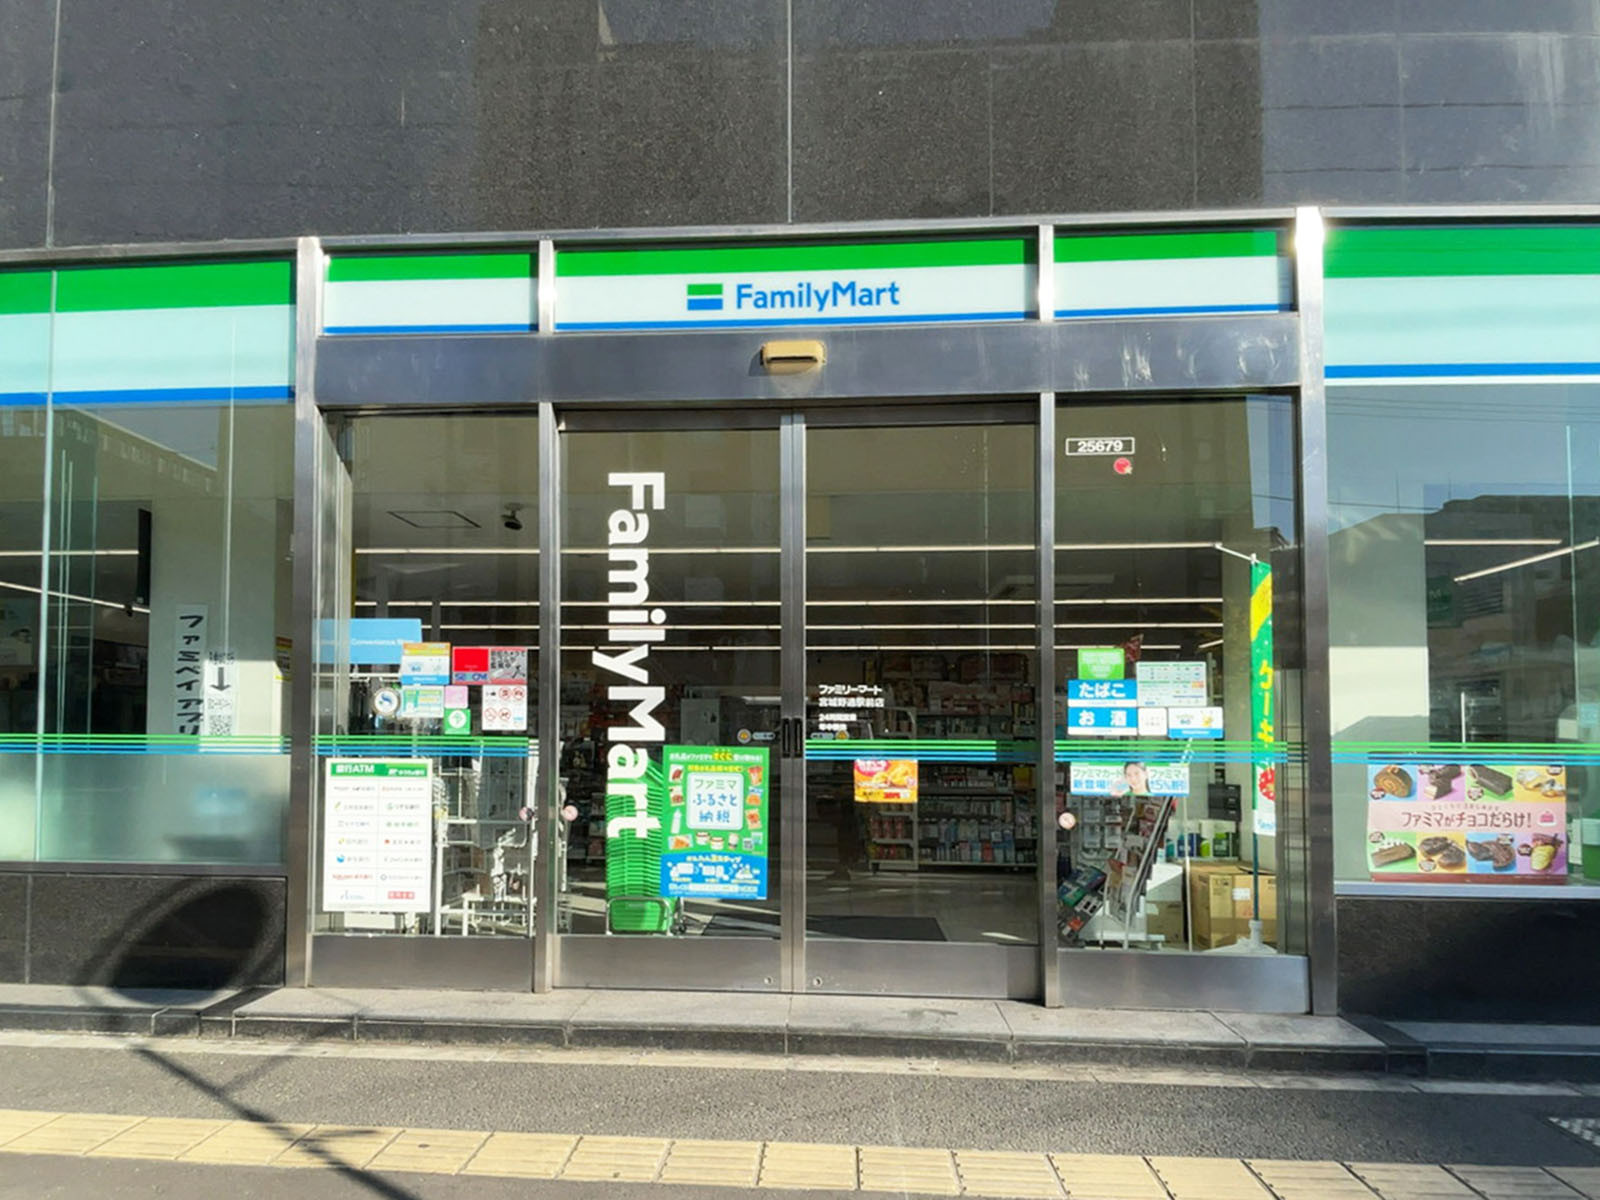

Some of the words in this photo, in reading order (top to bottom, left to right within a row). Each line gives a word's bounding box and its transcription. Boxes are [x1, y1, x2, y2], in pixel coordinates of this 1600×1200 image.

[736, 281, 900, 312] FamilyMart
[1077, 440, 1123, 452] 25679
[592, 472, 666, 840] FamilyMart
[818, 684, 882, 695] ファミリーマート
[1079, 683, 1126, 698] たばこ
[694, 780, 737, 790] ファミマ
[692, 793, 737, 807] ふるさと
[699, 810, 731, 824] 納税
[1401, 811, 1532, 828] ファミマがチョコだらけ!
